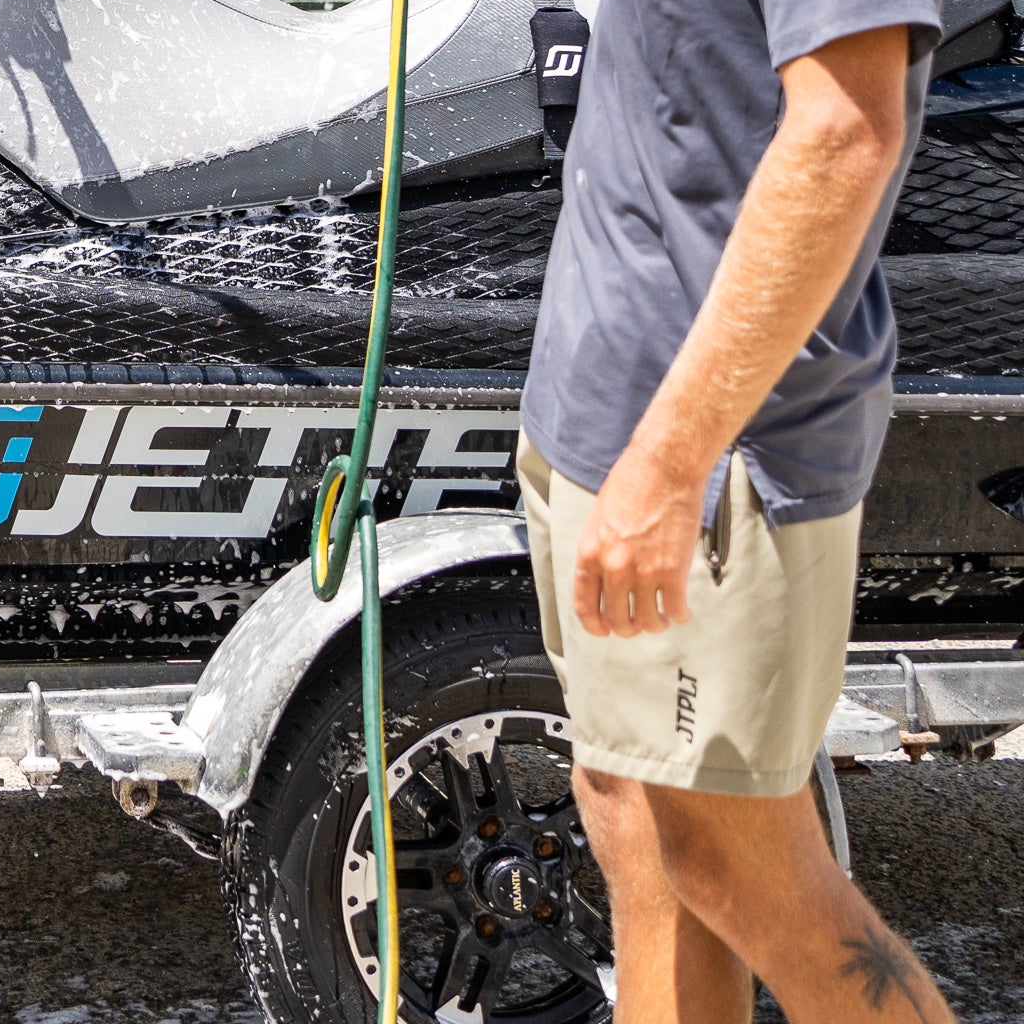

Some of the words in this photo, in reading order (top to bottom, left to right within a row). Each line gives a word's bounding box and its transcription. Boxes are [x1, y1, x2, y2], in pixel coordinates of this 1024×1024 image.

[10, 406, 523, 538] JETTE
[675, 667, 698, 744] JTPLT
[511, 868, 523, 912] ATLANTIC
